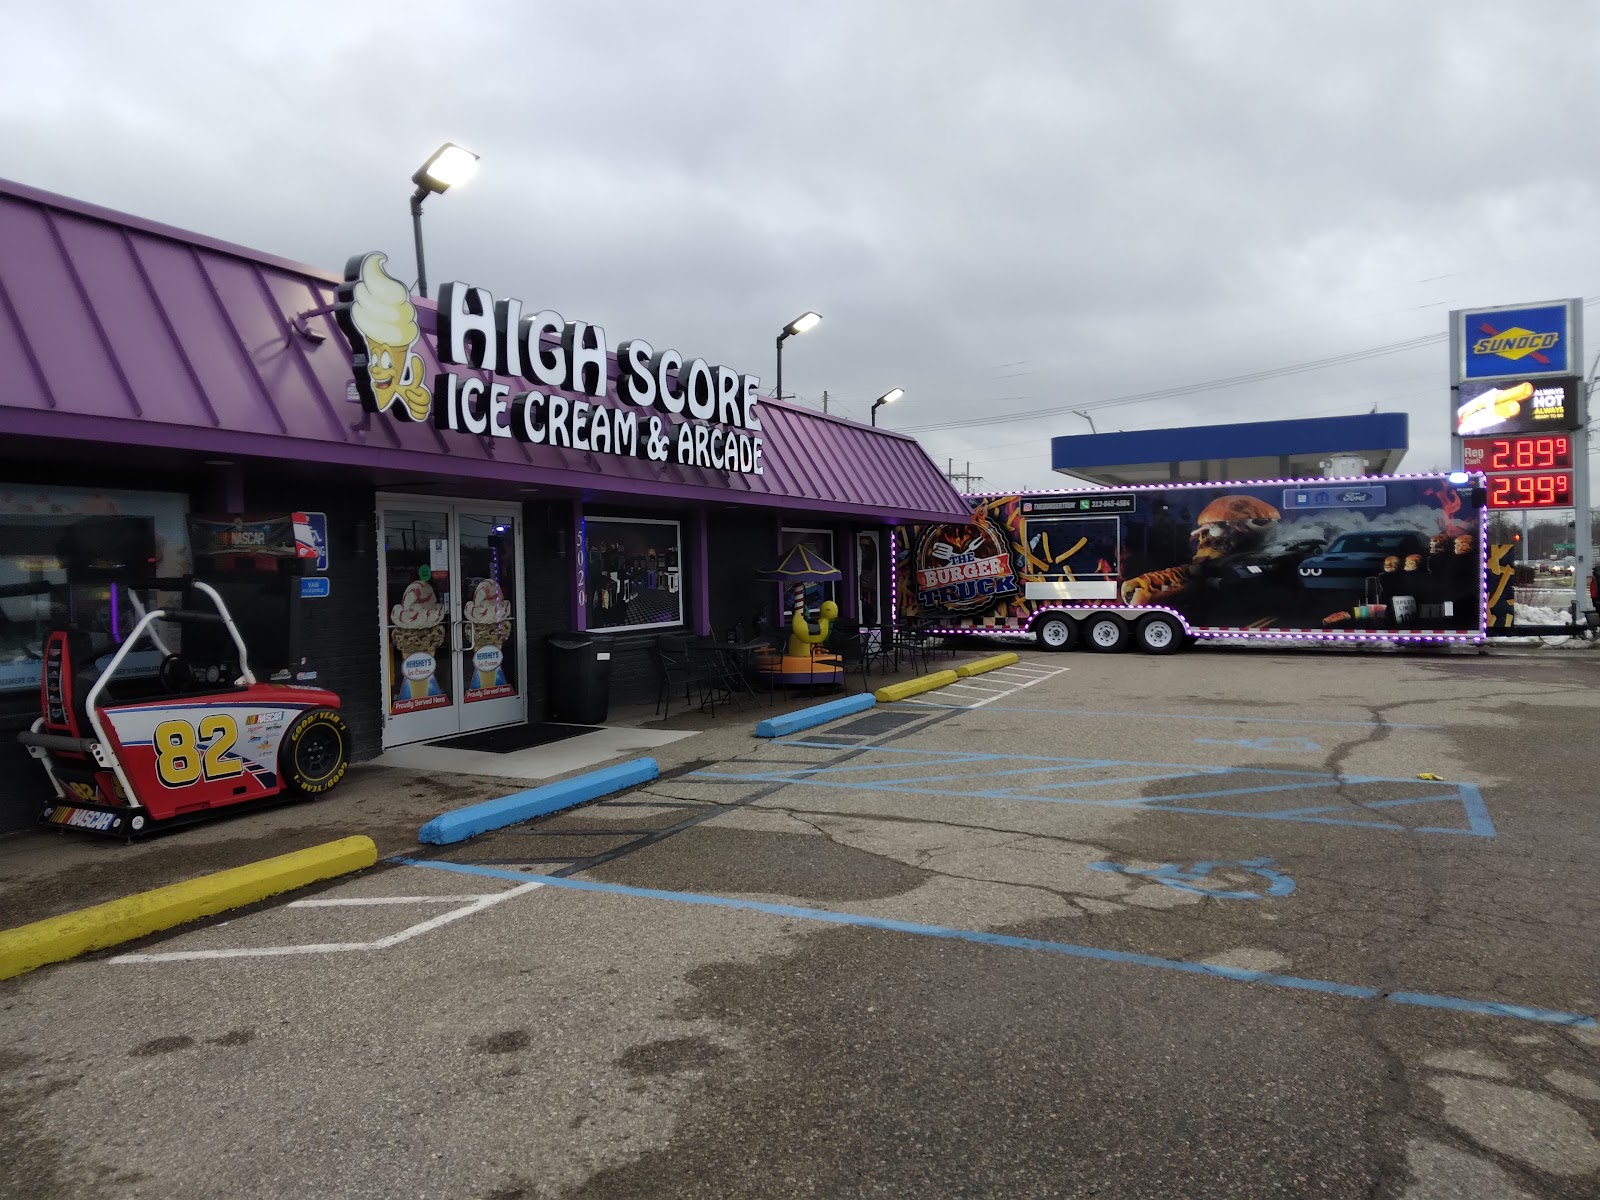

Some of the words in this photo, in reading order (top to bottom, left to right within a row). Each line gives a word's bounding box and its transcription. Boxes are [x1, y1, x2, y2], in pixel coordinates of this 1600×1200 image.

[1476, 332, 1559, 354] SUNOCO
[445, 280, 608, 397] HIGH
[624, 338, 763, 432] SCORE
[1533, 387, 1565, 396] ALWAYS
[1533, 395, 1565, 408] HOT
[1534, 406, 1564, 415] ALWAYS
[444, 373, 512, 439] ICE
[522, 389, 638, 457] CREAM
[646, 415, 670, 463] &
[677, 424, 765, 476] ARCADE
[1464, 447, 1484, 459] Reg
[1464, 457, 1481, 465] Cash
[1342, 491, 1367, 502] Ford
[230, 531, 266, 545] NASCAR
[950, 552, 975, 566] THE
[576, 530, 586, 607] 5020
[924, 557, 1005, 588] BURGER
[918, 576, 1017, 607] TRUCK
[476, 651, 499, 660] HERSHEY'S
[406, 658, 432, 668] HERSHEY'S
[415, 668, 431, 676] Cream
[467, 689, 483, 698] Proudly
[484, 687, 499, 695] Served
[395, 699, 414, 709] Proudly
[415, 697, 433, 706] Served
[257, 711, 284, 723] NASCAR
[291, 711, 340, 742] GOODYEAR
[153, 713, 245, 790] 82
[300, 761, 349, 793] GOODYEAR
[69, 781, 100, 801] 82
[67, 808, 115, 830] NASCAR
